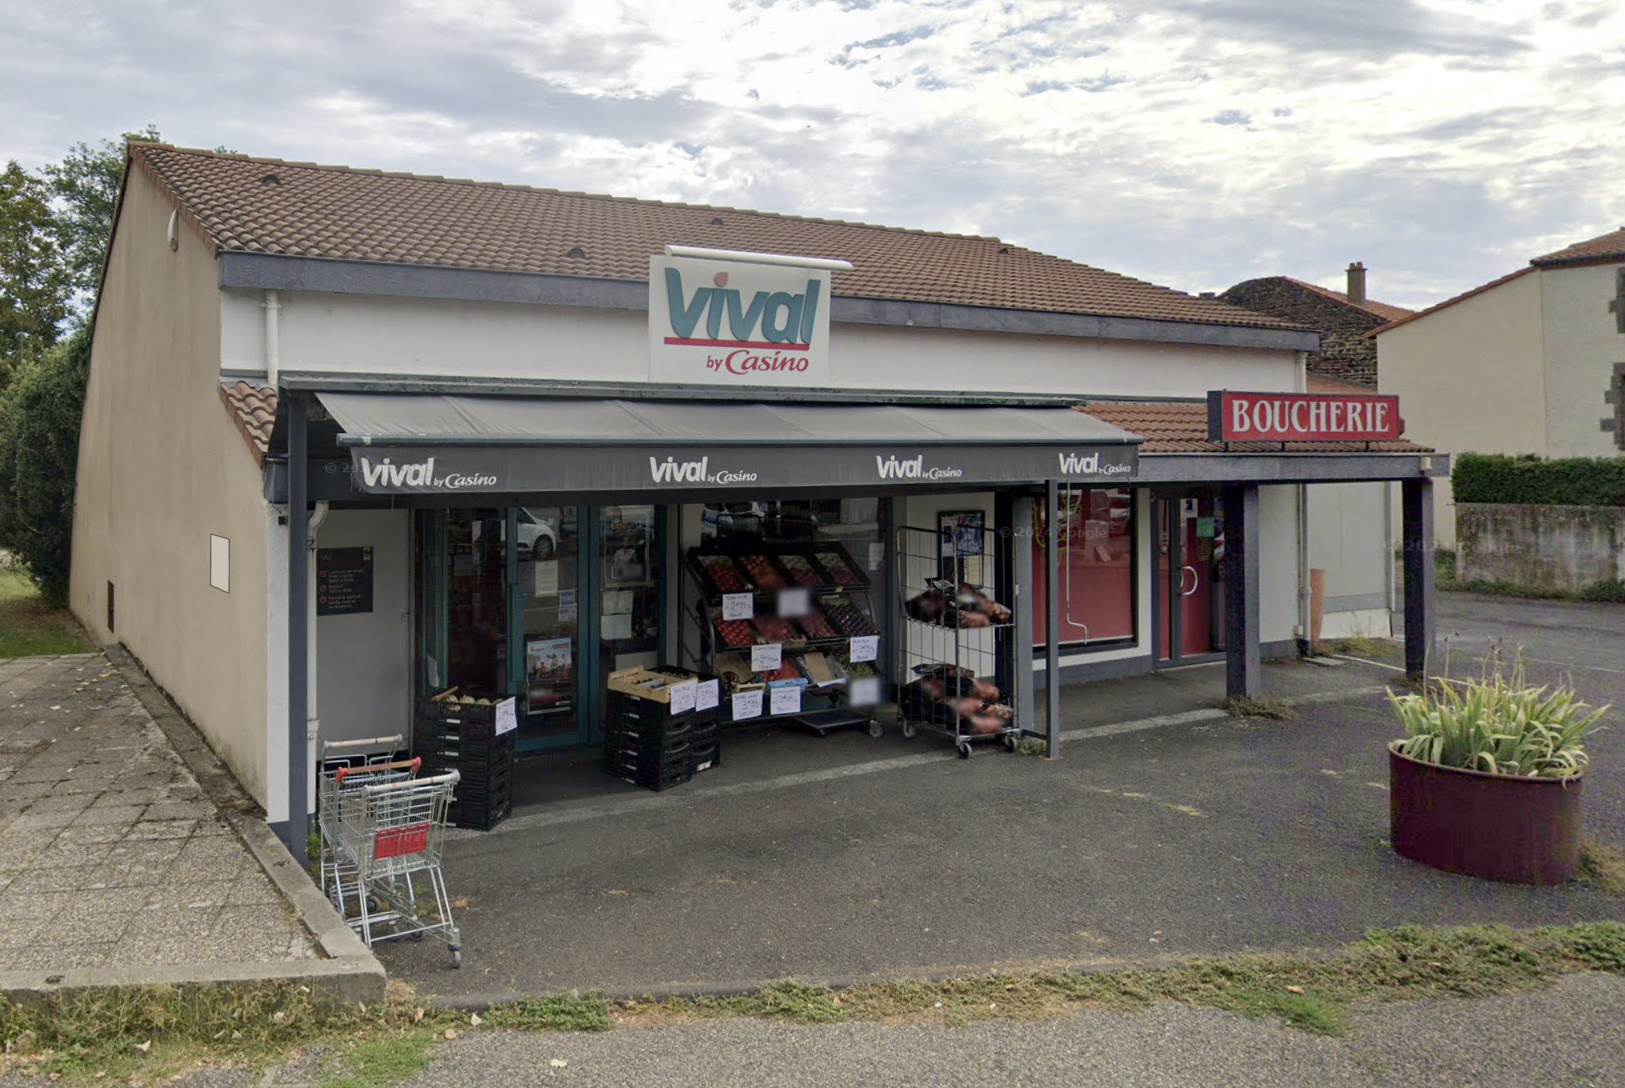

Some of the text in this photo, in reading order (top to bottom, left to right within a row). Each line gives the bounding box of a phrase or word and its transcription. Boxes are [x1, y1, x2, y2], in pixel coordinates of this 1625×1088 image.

[665, 267, 821, 344] Vival
[706, 349, 809, 375] by Casino
[1231, 399, 1390, 433] BOUCHERIE
[361, 457, 497, 489] Vival by Casino
[649, 456, 709, 483] Vival
[716, 470, 758, 485] Casino
[876, 454, 923, 479] Vival
[929, 466, 963, 480] Casino
[1058, 452, 1099, 475] Vival
[1103, 463, 1132, 475] Casino
